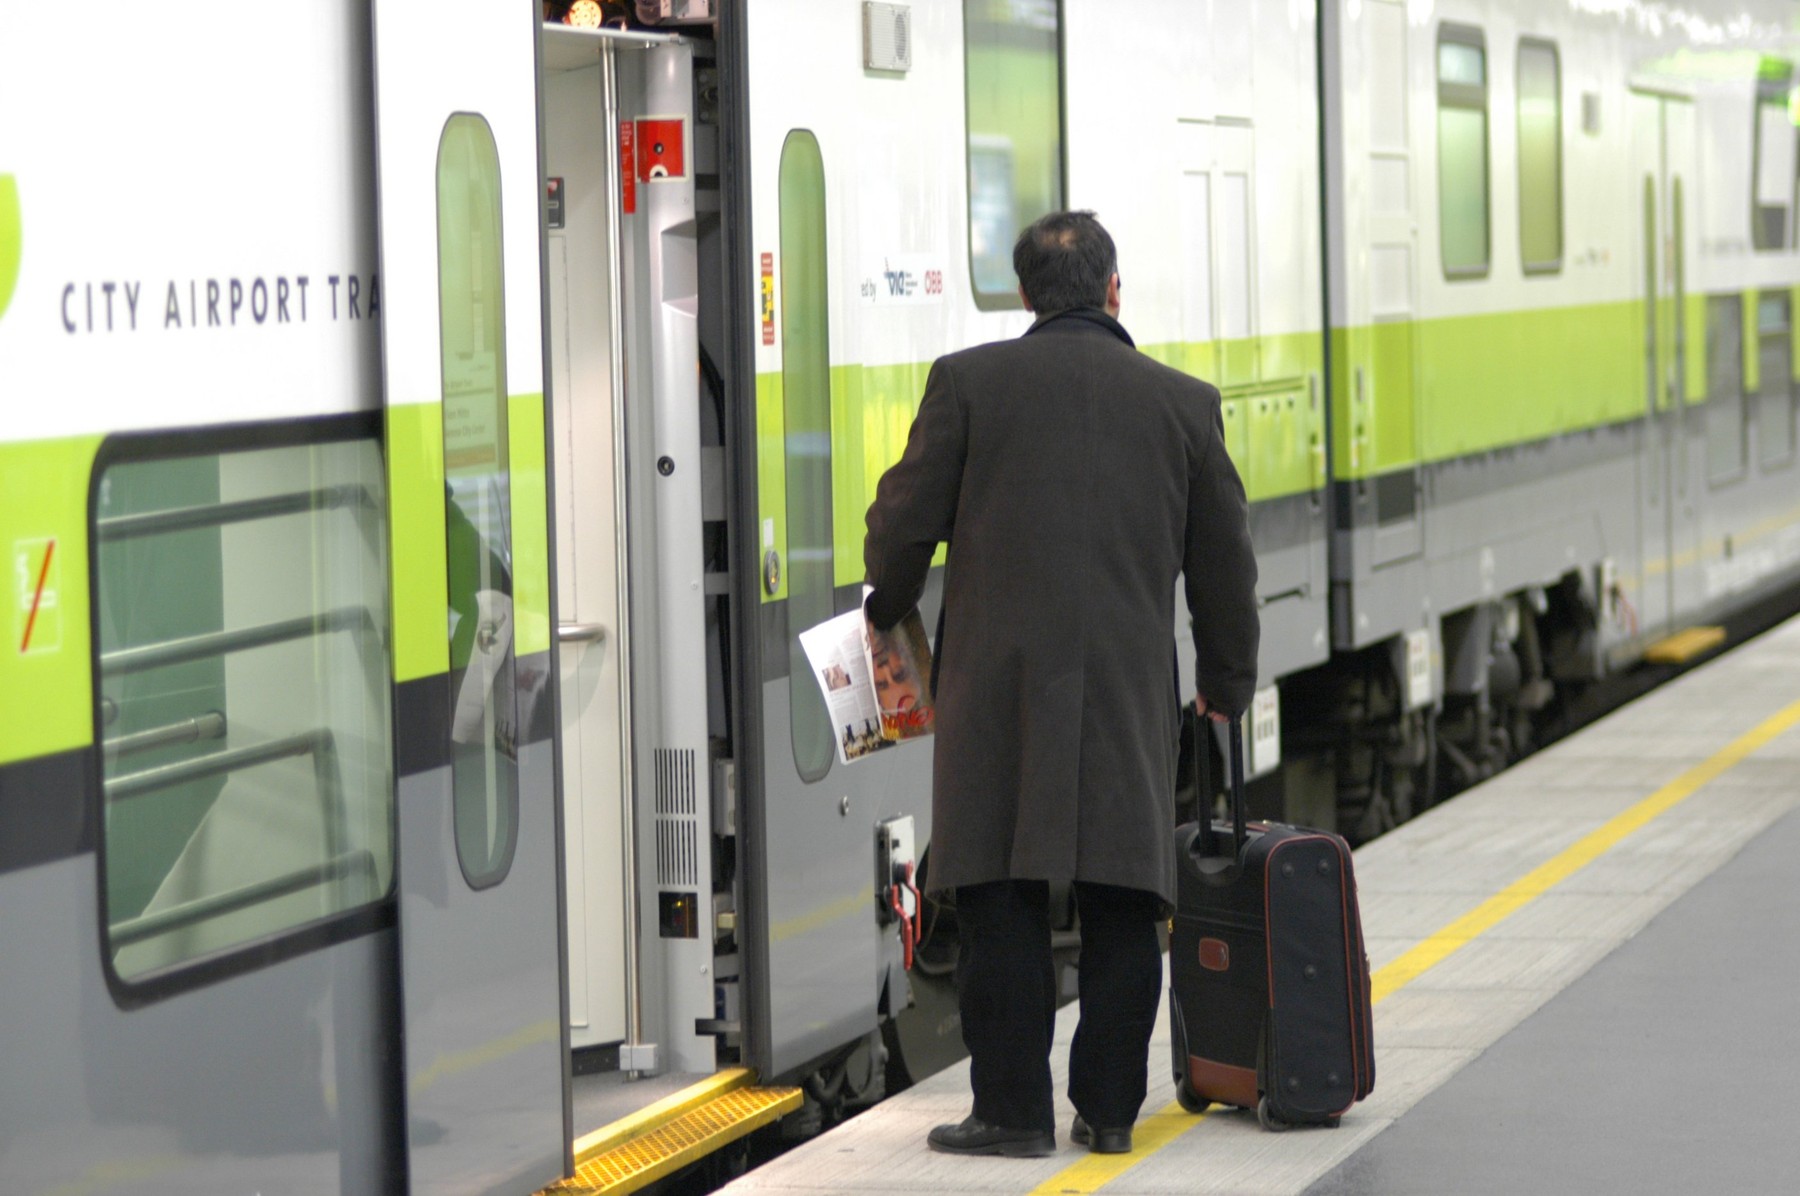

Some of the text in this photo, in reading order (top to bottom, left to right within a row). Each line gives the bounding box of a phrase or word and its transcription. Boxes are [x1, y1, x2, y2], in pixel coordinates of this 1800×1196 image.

[61, 272, 381, 334] CITY AIRPORT TRA
